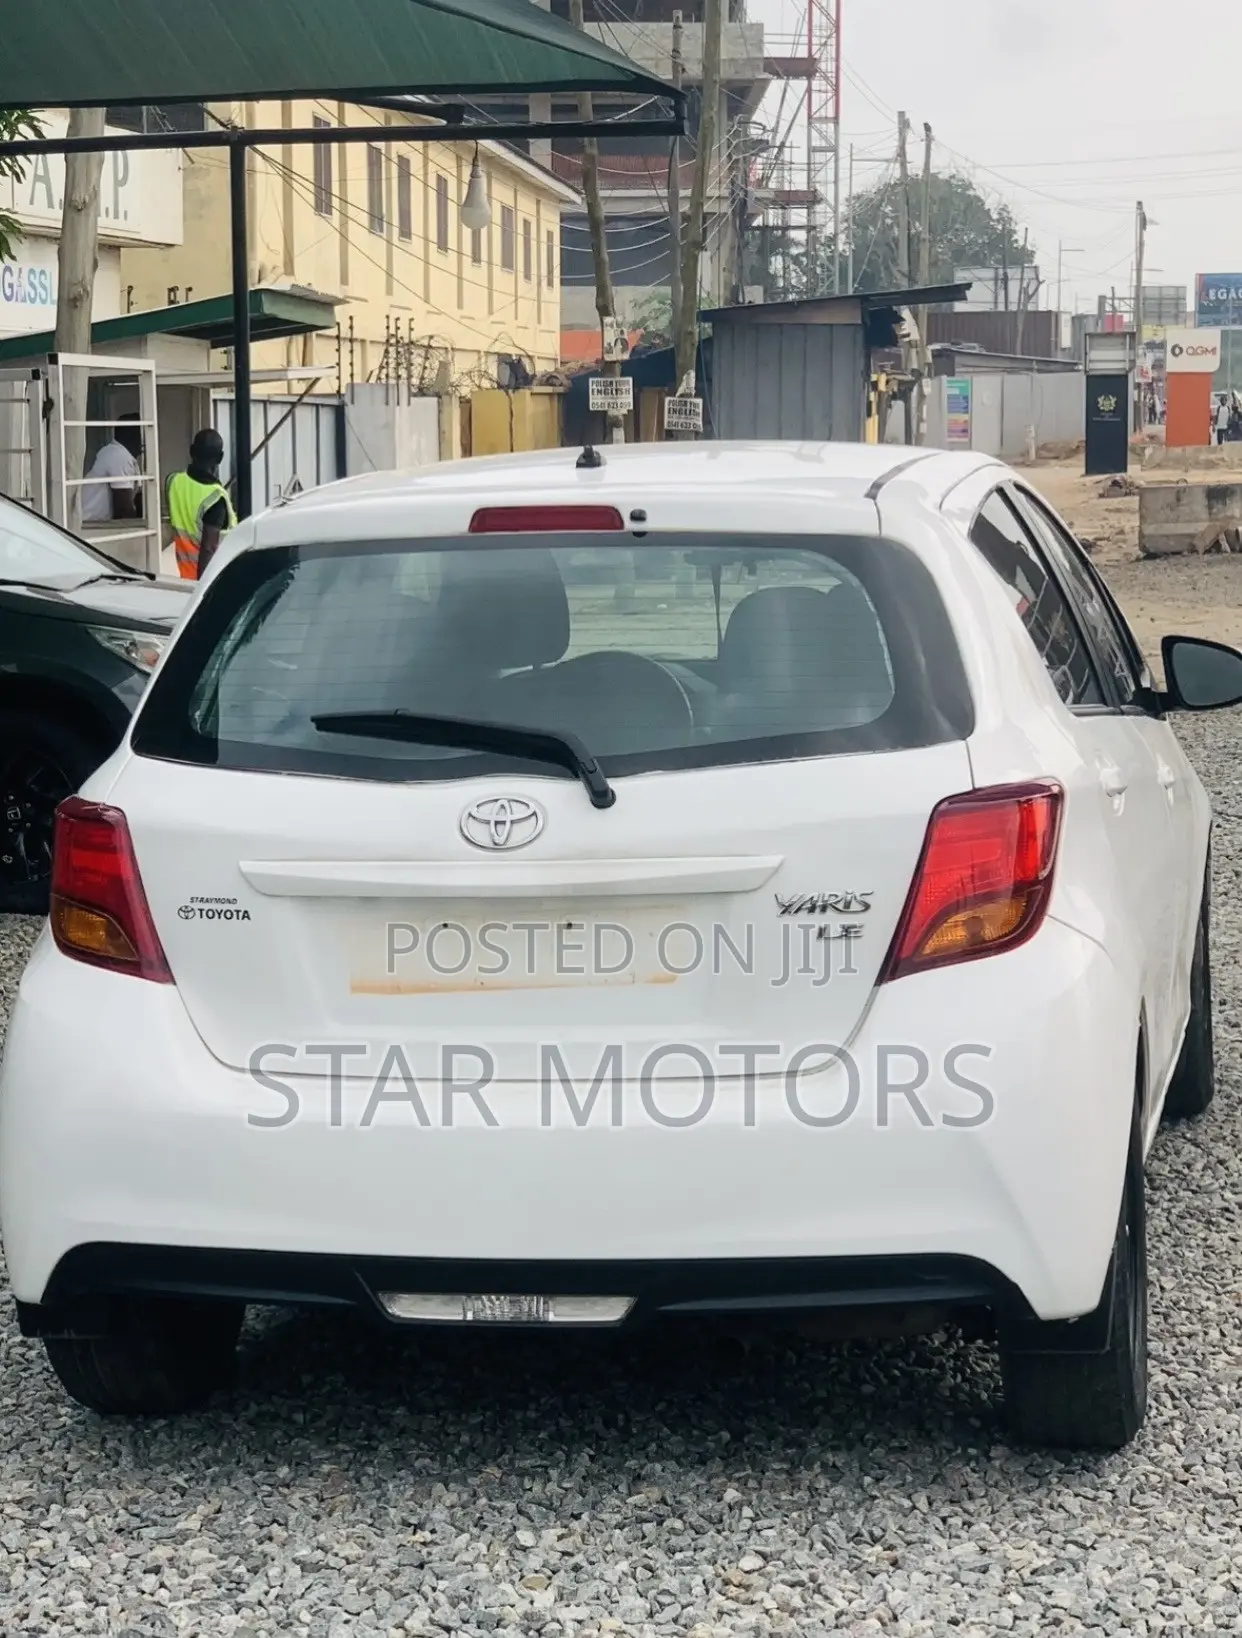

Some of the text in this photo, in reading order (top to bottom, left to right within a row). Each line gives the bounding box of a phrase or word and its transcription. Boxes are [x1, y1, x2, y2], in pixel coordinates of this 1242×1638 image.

[591, 388, 631, 396] ENGLISH
[668, 407, 700, 417] ENGLISH
[197, 908, 252, 921] TOYOTA
